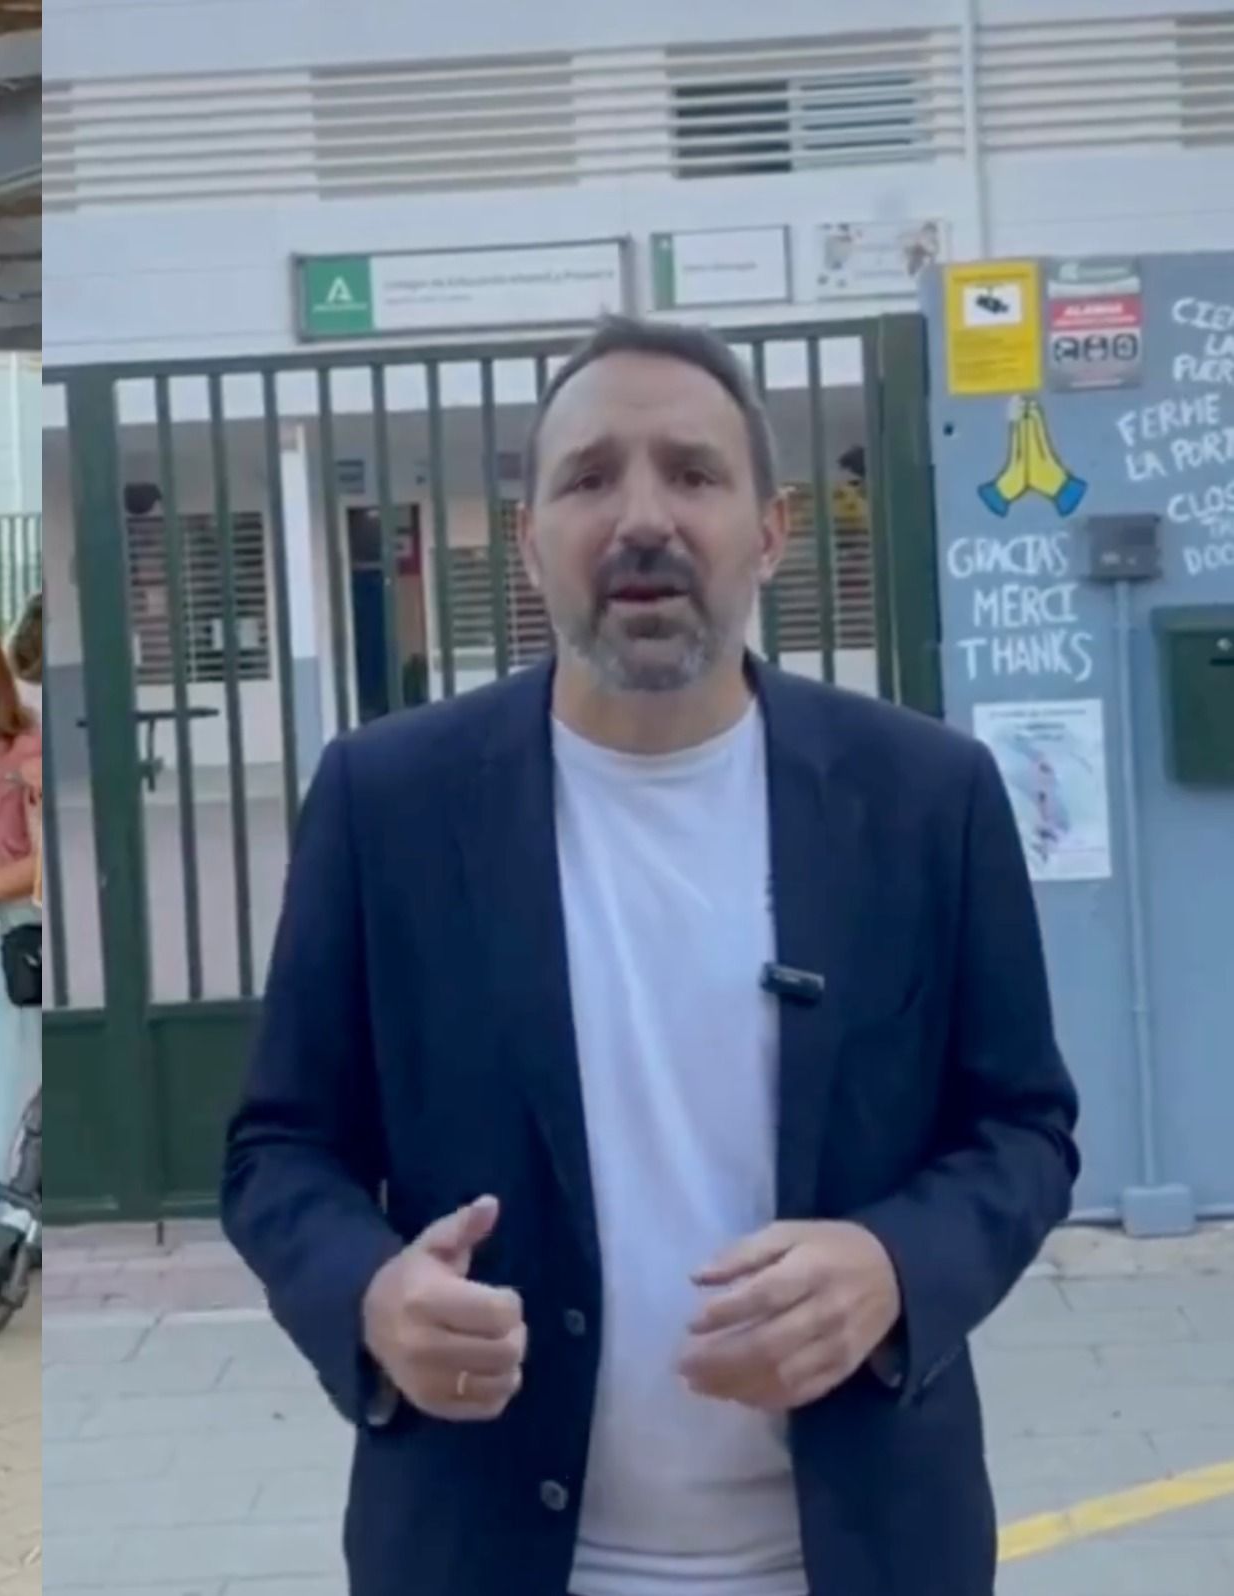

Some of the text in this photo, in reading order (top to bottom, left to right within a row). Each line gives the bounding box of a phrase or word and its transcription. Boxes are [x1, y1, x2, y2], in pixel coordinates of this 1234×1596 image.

[1116, 394, 1221, 447] FERME
[1125, 451, 1167, 482] LA
[948, 531, 1070, 578] GRACIAS
[973, 582, 1079, 629] MERCI
[956, 628, 1094, 683] THANKS
